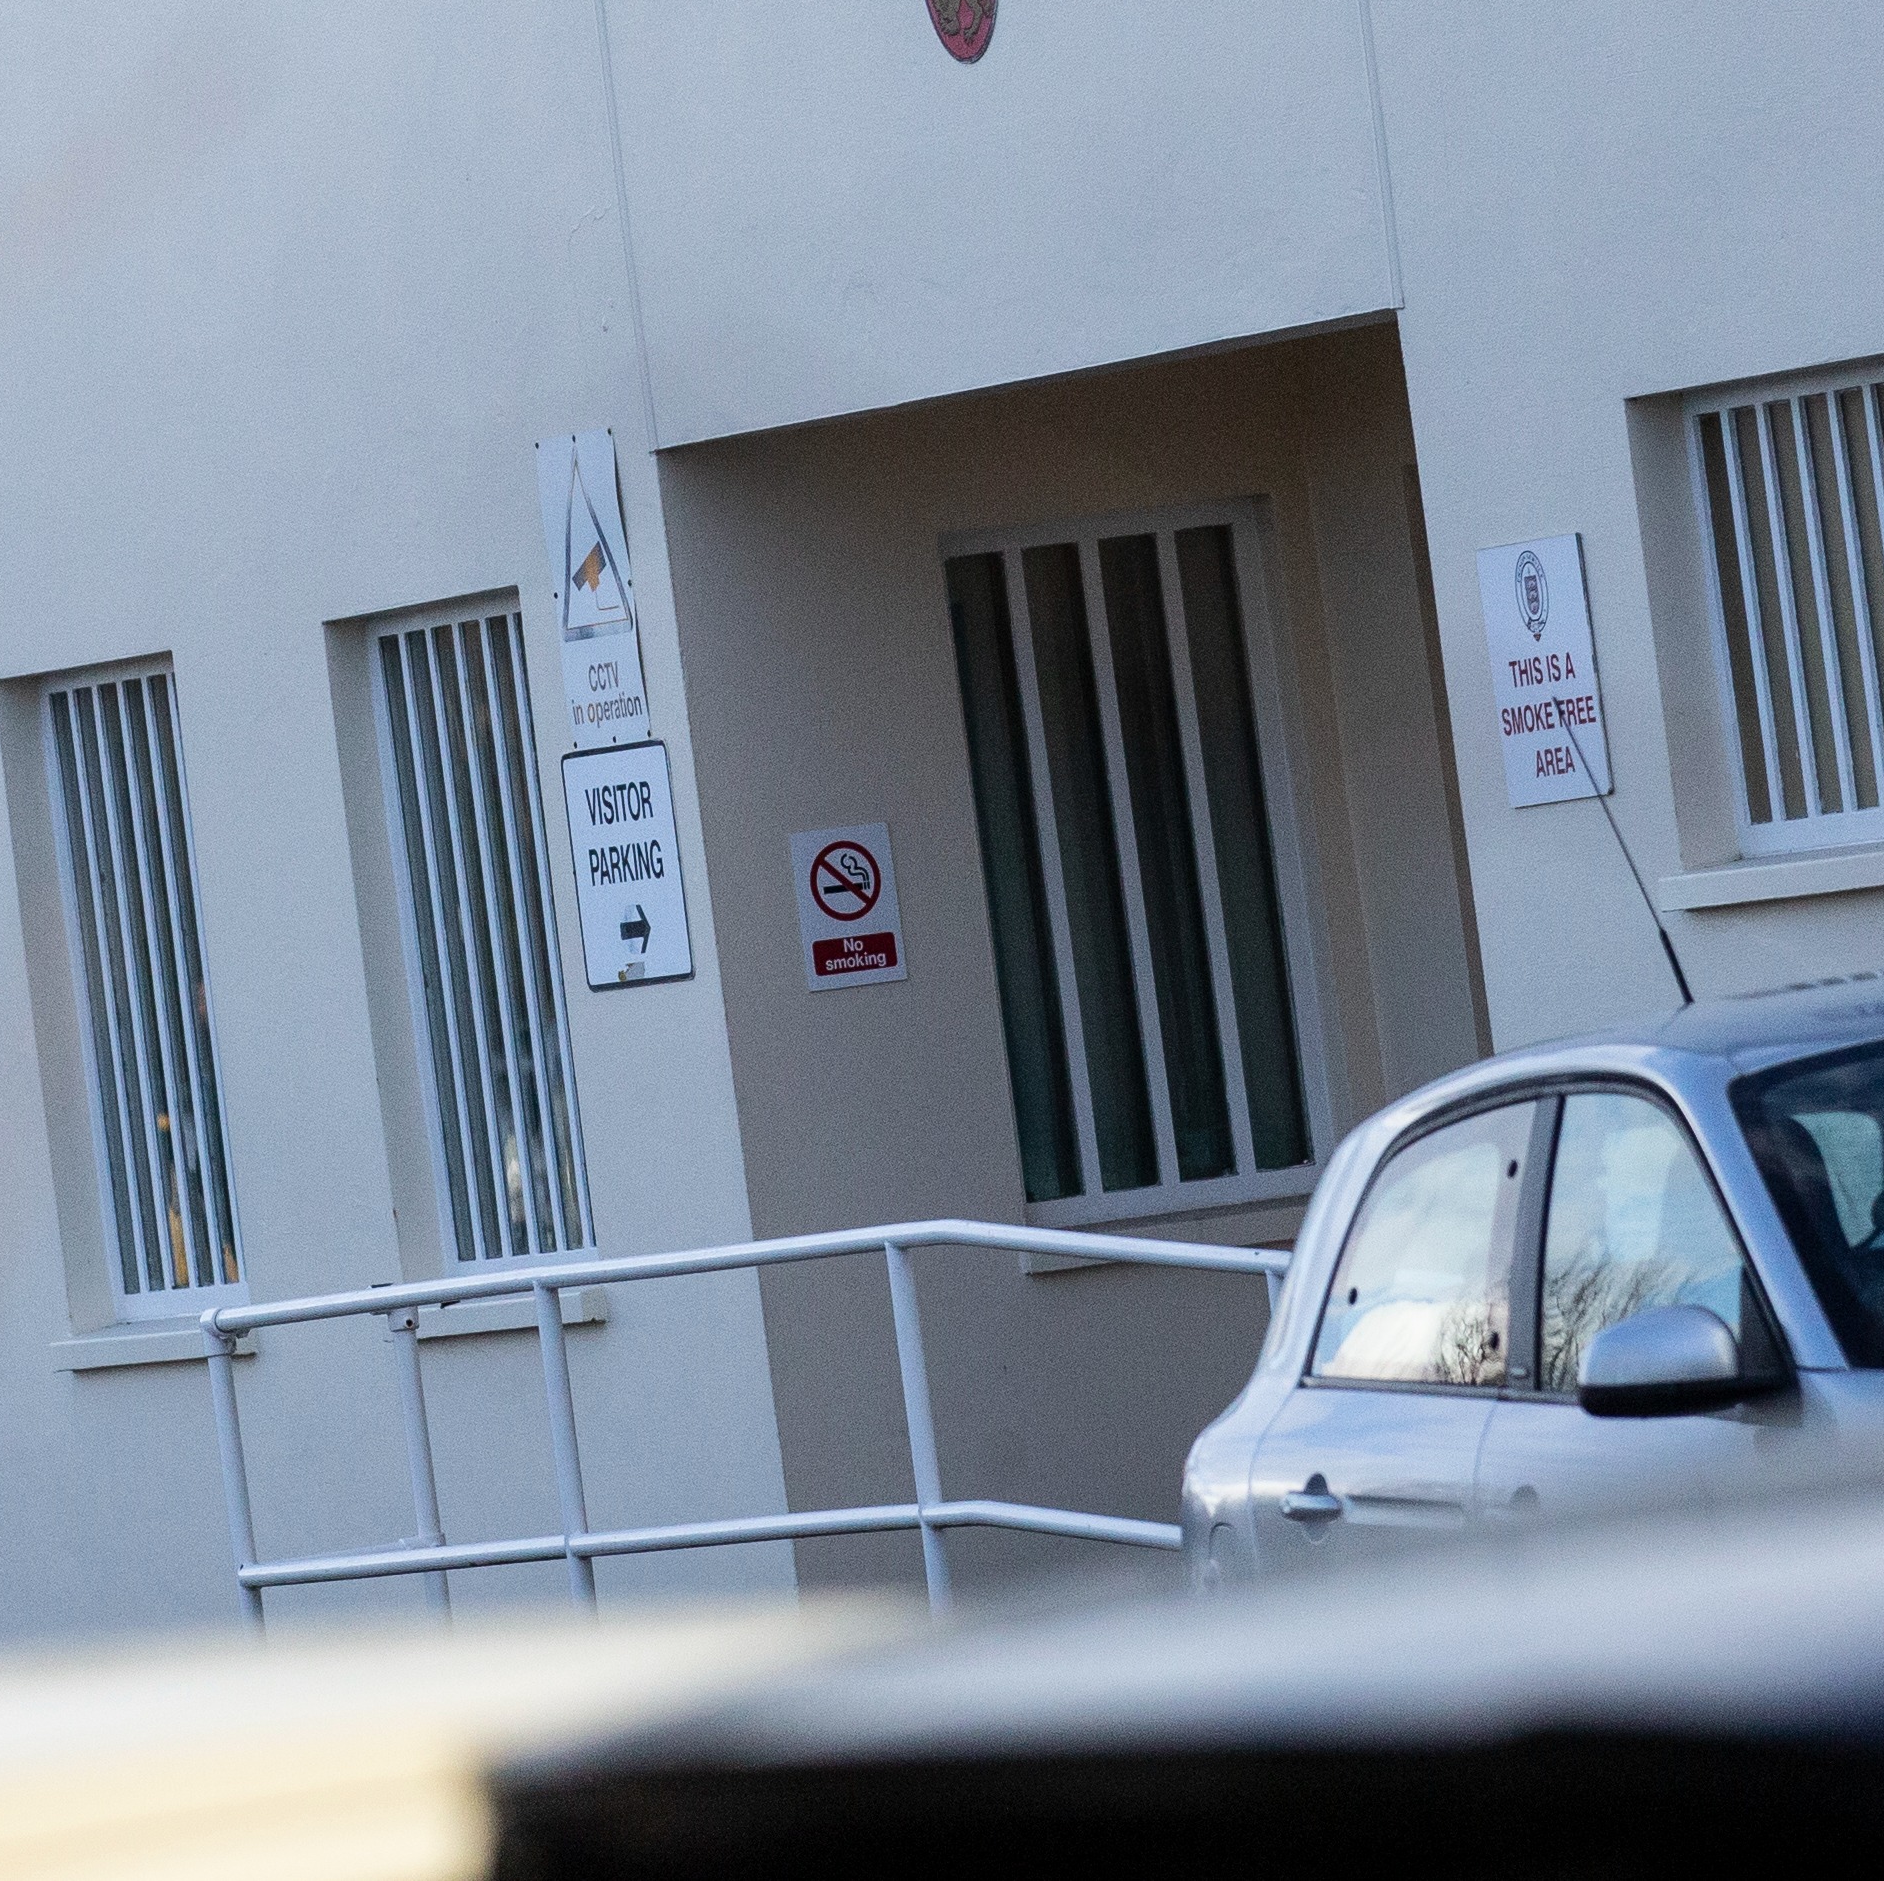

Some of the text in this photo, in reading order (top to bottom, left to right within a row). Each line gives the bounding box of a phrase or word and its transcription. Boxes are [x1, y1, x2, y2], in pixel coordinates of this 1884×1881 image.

[588, 661, 619, 692] CCTV
[1508, 651, 1576, 688] THIS IS A
[571, 691, 643, 729] in operation
[1501, 695, 1597, 736] SMOKE FREE
[1536, 746, 1576, 779] AREA
[584, 781, 654, 826] VISITOR
[588, 839, 665, 887] PARKING
[825, 952, 887, 971] smoking
[843, 938, 864, 953] No
